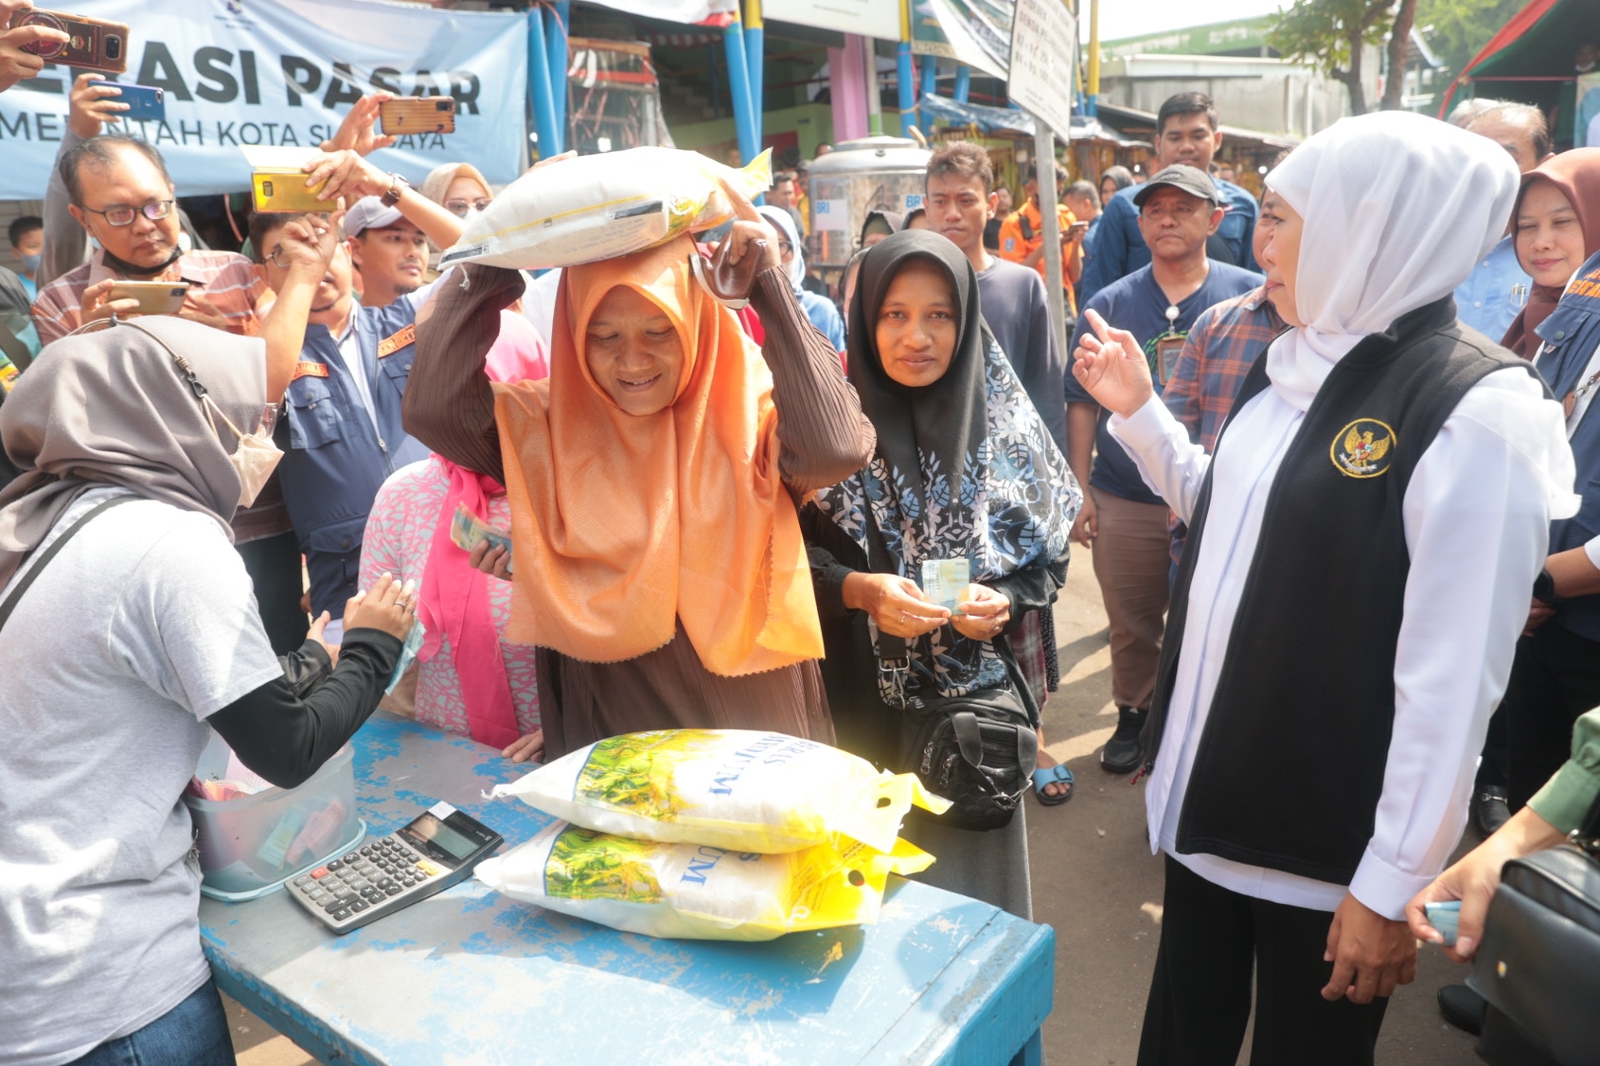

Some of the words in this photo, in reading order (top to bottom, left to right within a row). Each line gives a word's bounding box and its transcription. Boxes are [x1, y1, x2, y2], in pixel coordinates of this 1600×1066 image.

[280, 54, 482, 116] PASAR
[0, 111, 204, 145] MENTAH
[217, 121, 300, 147] KOTA
[816, 201, 830, 214] BRI
